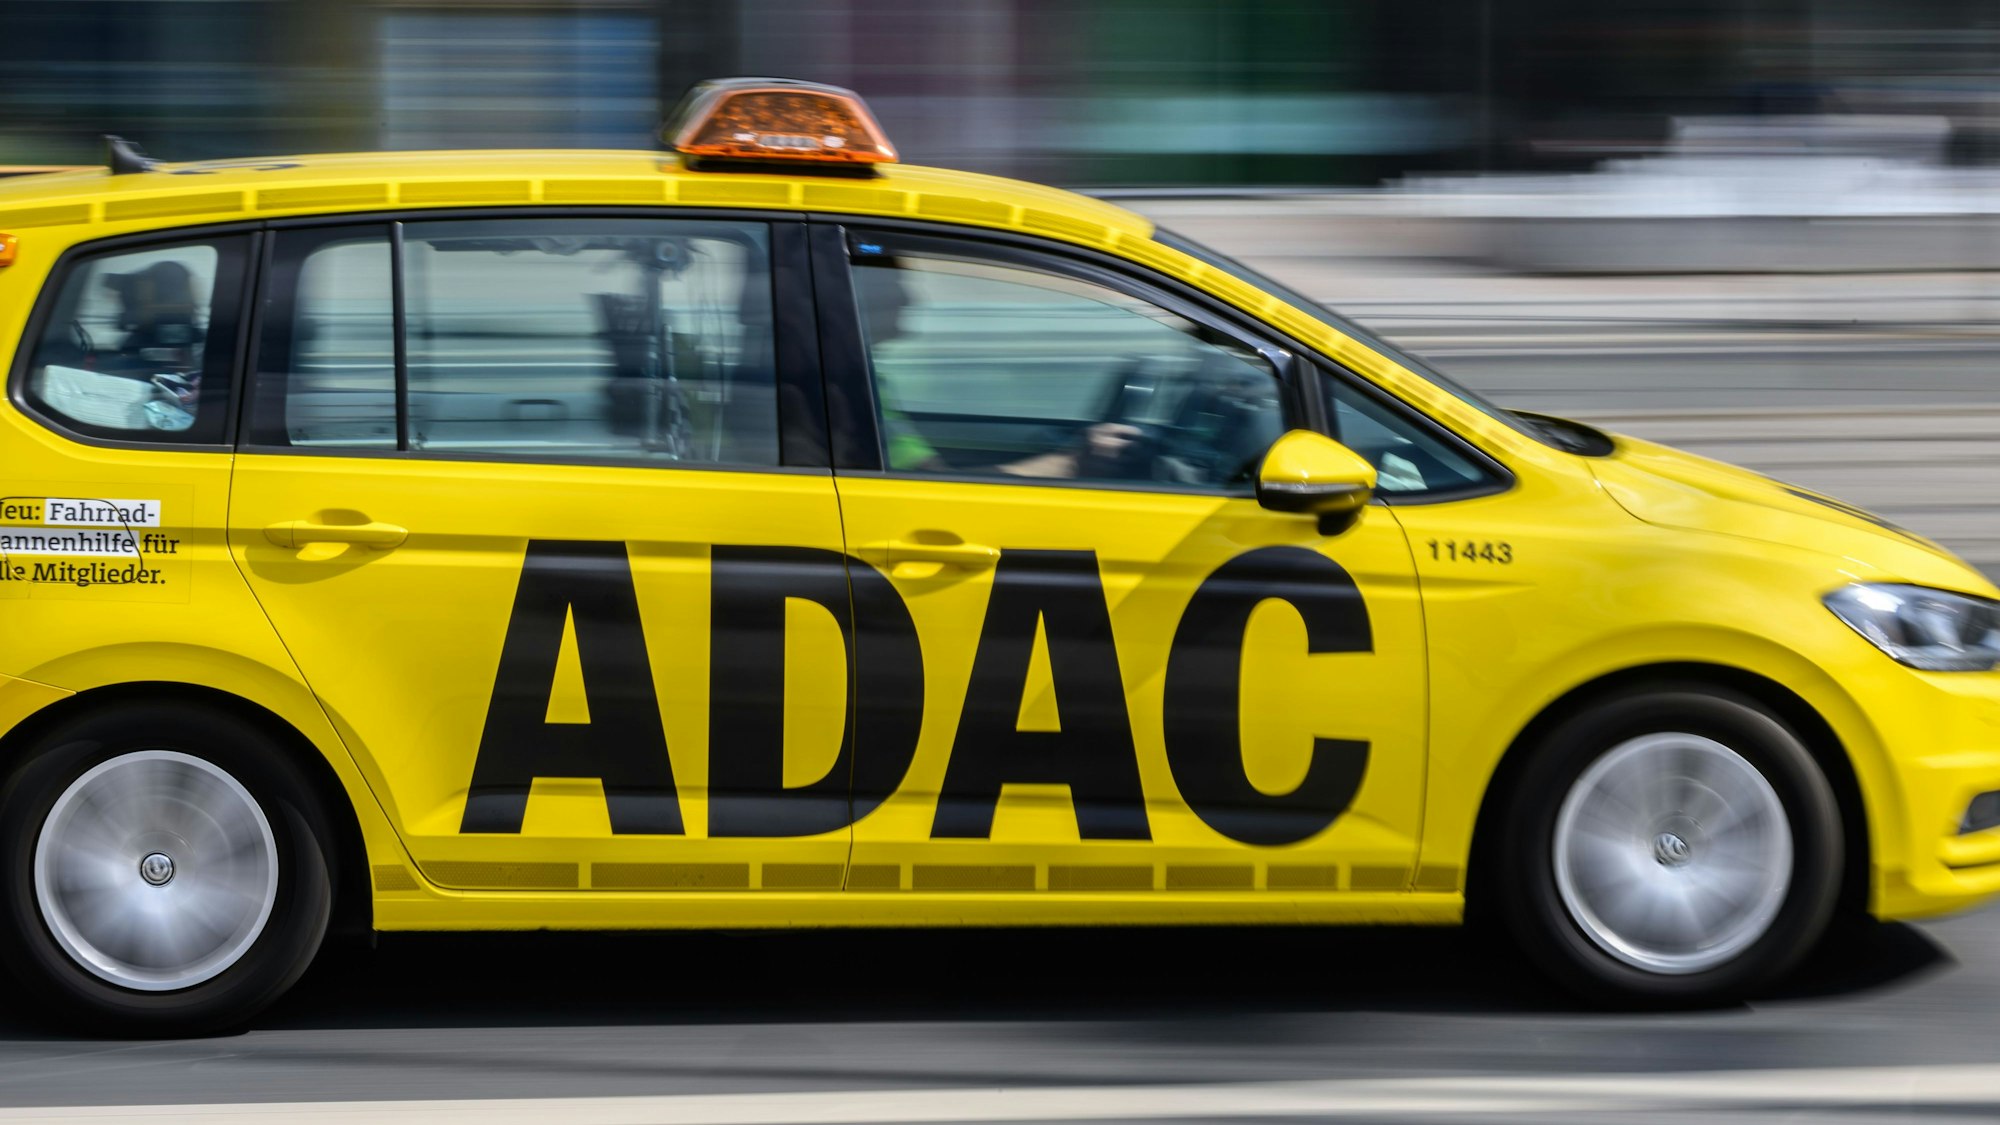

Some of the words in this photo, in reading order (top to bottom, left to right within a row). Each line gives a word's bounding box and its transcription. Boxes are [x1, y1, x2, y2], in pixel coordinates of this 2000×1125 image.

[49, 502, 156, 523] Fahrrad-
[0, 532, 134, 553] annenhilfe
[143, 534, 180, 554] für
[1427, 539, 1513, 564] 11443
[0, 560, 26, 581] lle
[32, 561, 166, 587] Mitglieder.
[459, 538, 1374, 848] ADAC
